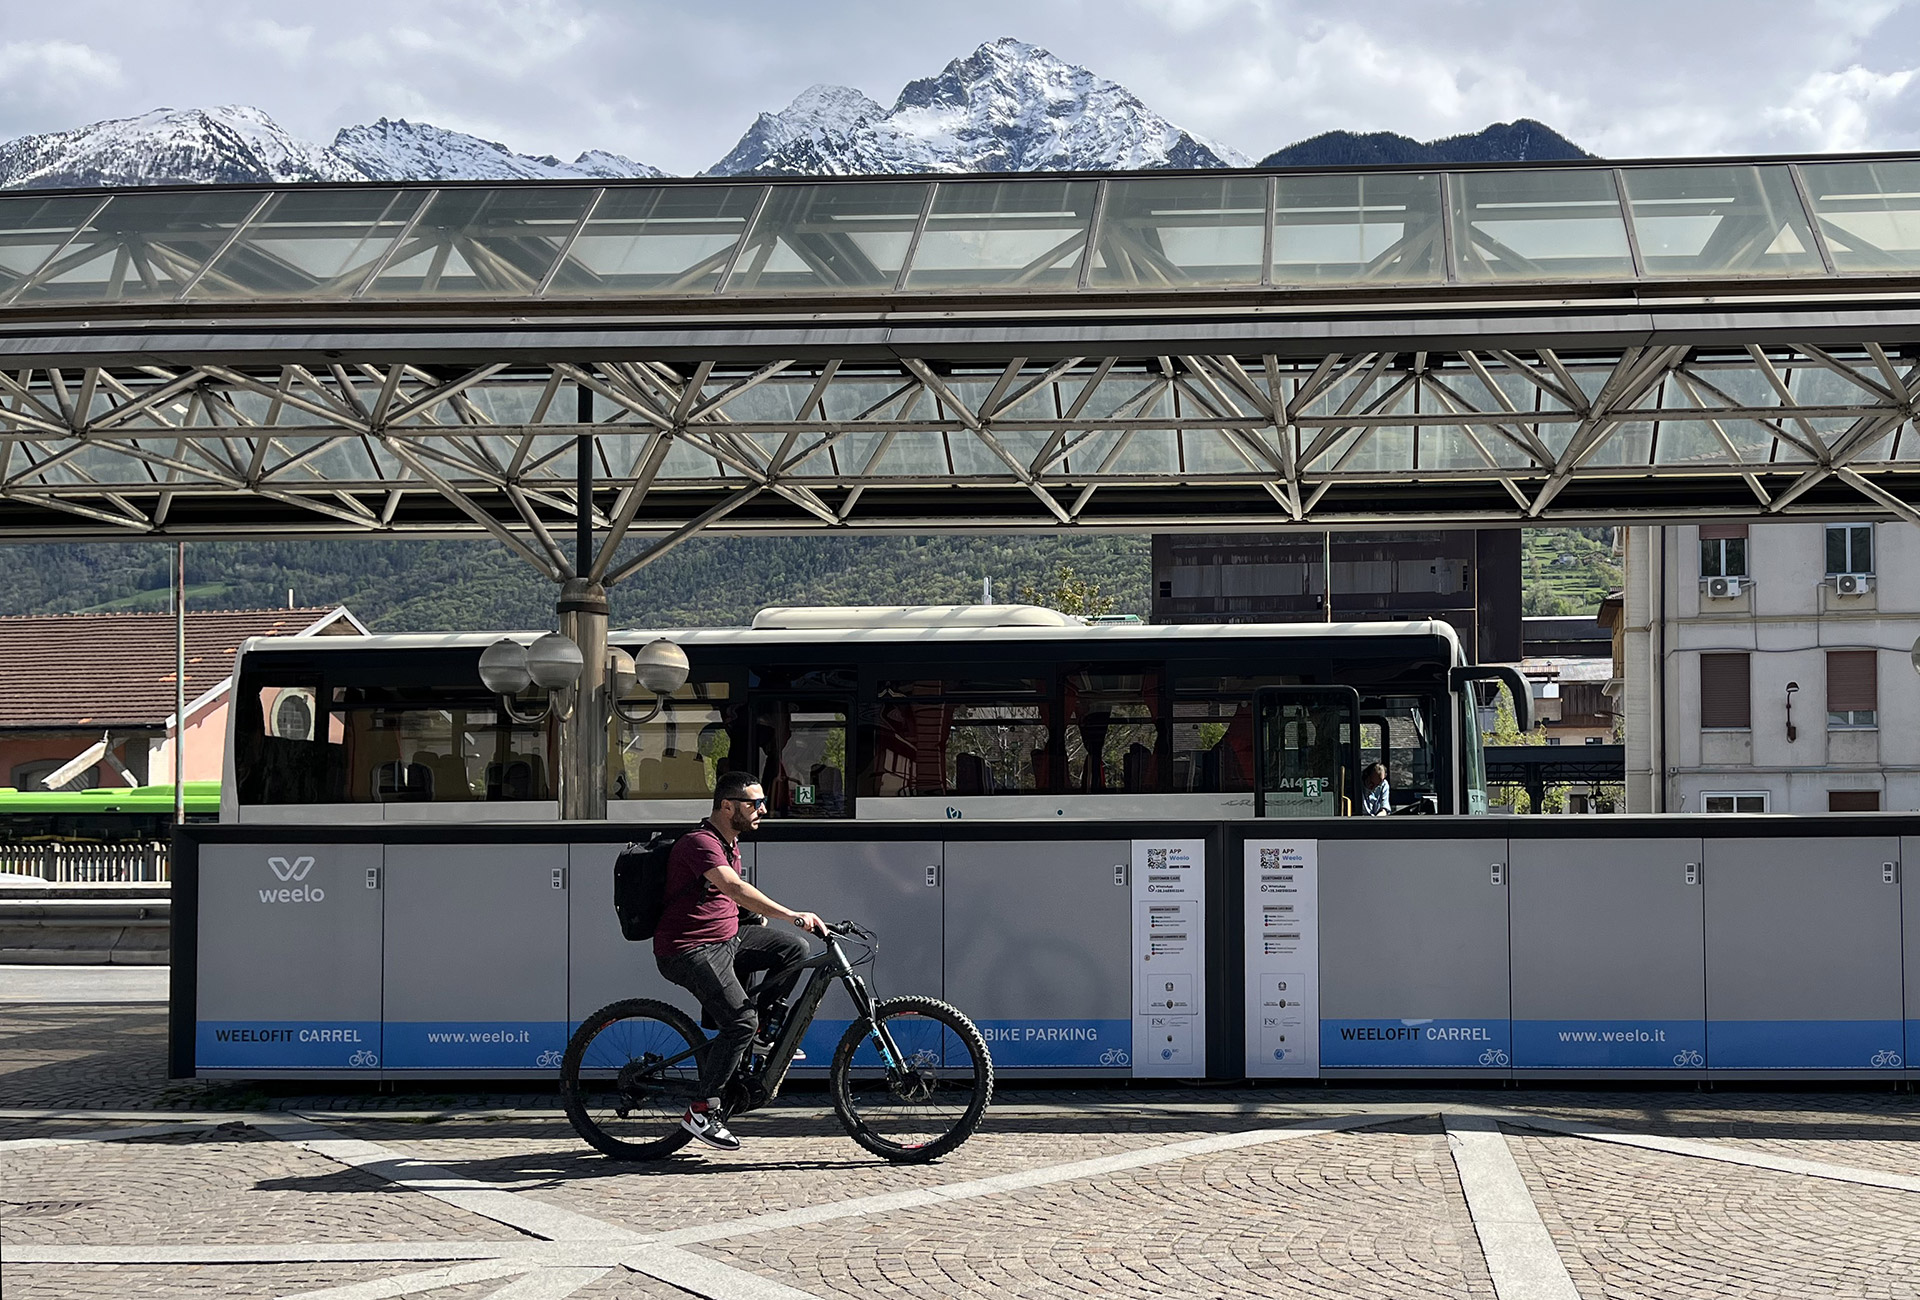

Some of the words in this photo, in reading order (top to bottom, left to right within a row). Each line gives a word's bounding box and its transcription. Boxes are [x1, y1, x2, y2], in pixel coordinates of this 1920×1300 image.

[1279, 777, 1329, 788] AI45
[259, 884, 325, 903] weelo
[215, 1029, 294, 1042] WEELOFIT
[299, 1029, 361, 1042] CARREL
[427, 1030, 530, 1043] www.weelo.it
[984, 1028, 1020, 1041] BIKE
[1025, 1028, 1098, 1041] PARKING
[1340, 1027, 1420, 1041] WEELOFIT
[1426, 1027, 1491, 1041] CARREL
[1558, 1029, 1666, 1042] www.weelo.it
